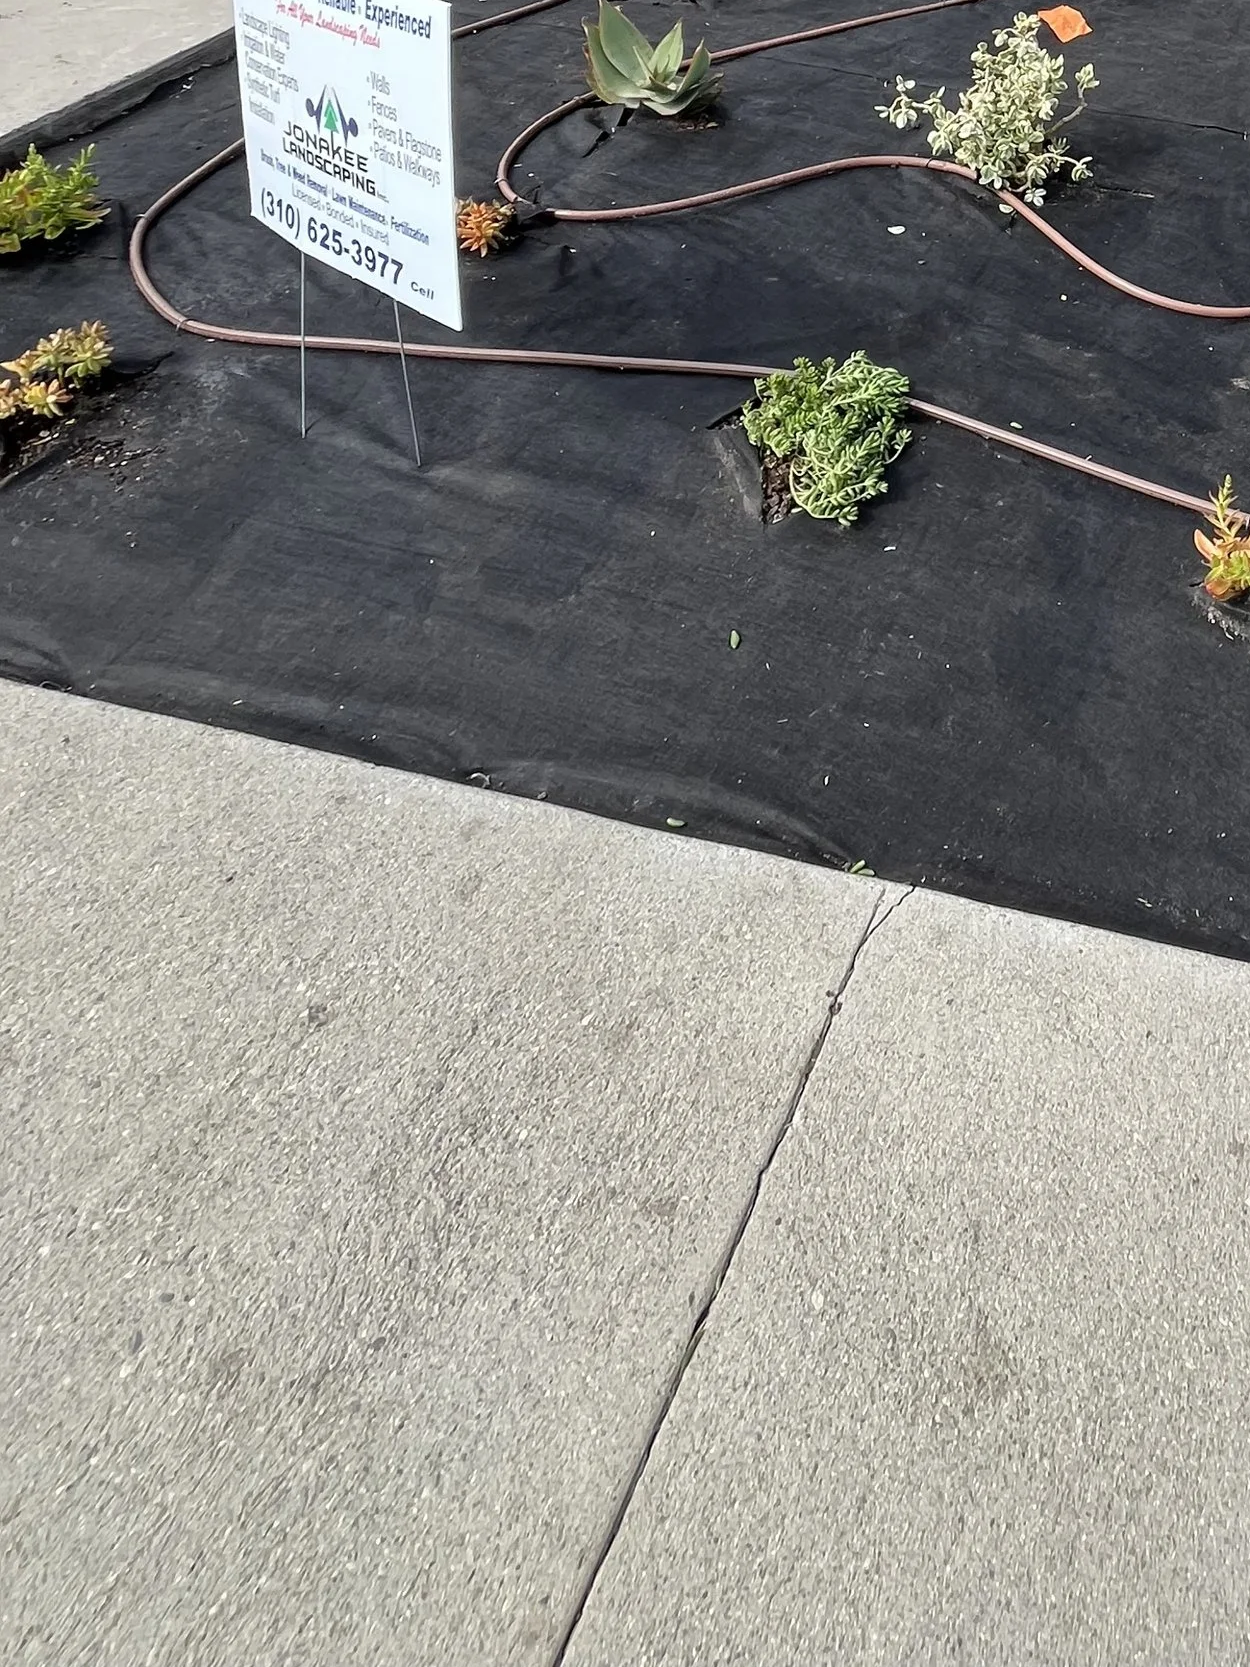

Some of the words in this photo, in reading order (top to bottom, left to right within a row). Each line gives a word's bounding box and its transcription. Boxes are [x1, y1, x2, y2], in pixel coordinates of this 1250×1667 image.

[316, 10, 357, 46] Landscaping
[359, 24, 380, 48] Needs
[370, 71, 390, 95] Walls
[371, 95, 397, 122] Fences
[283, 121, 369, 173] JONAKEE
[373, 118, 397, 144] Pavers
[406, 131, 442, 163] Flagstone
[283, 137, 376, 196] LANDSCAPING
[404, 154, 441, 188] Walkways
[261, 187, 300, 239] (310)
[307, 217, 404, 285] 625-3977
[411, 281, 434, 300] Cell
